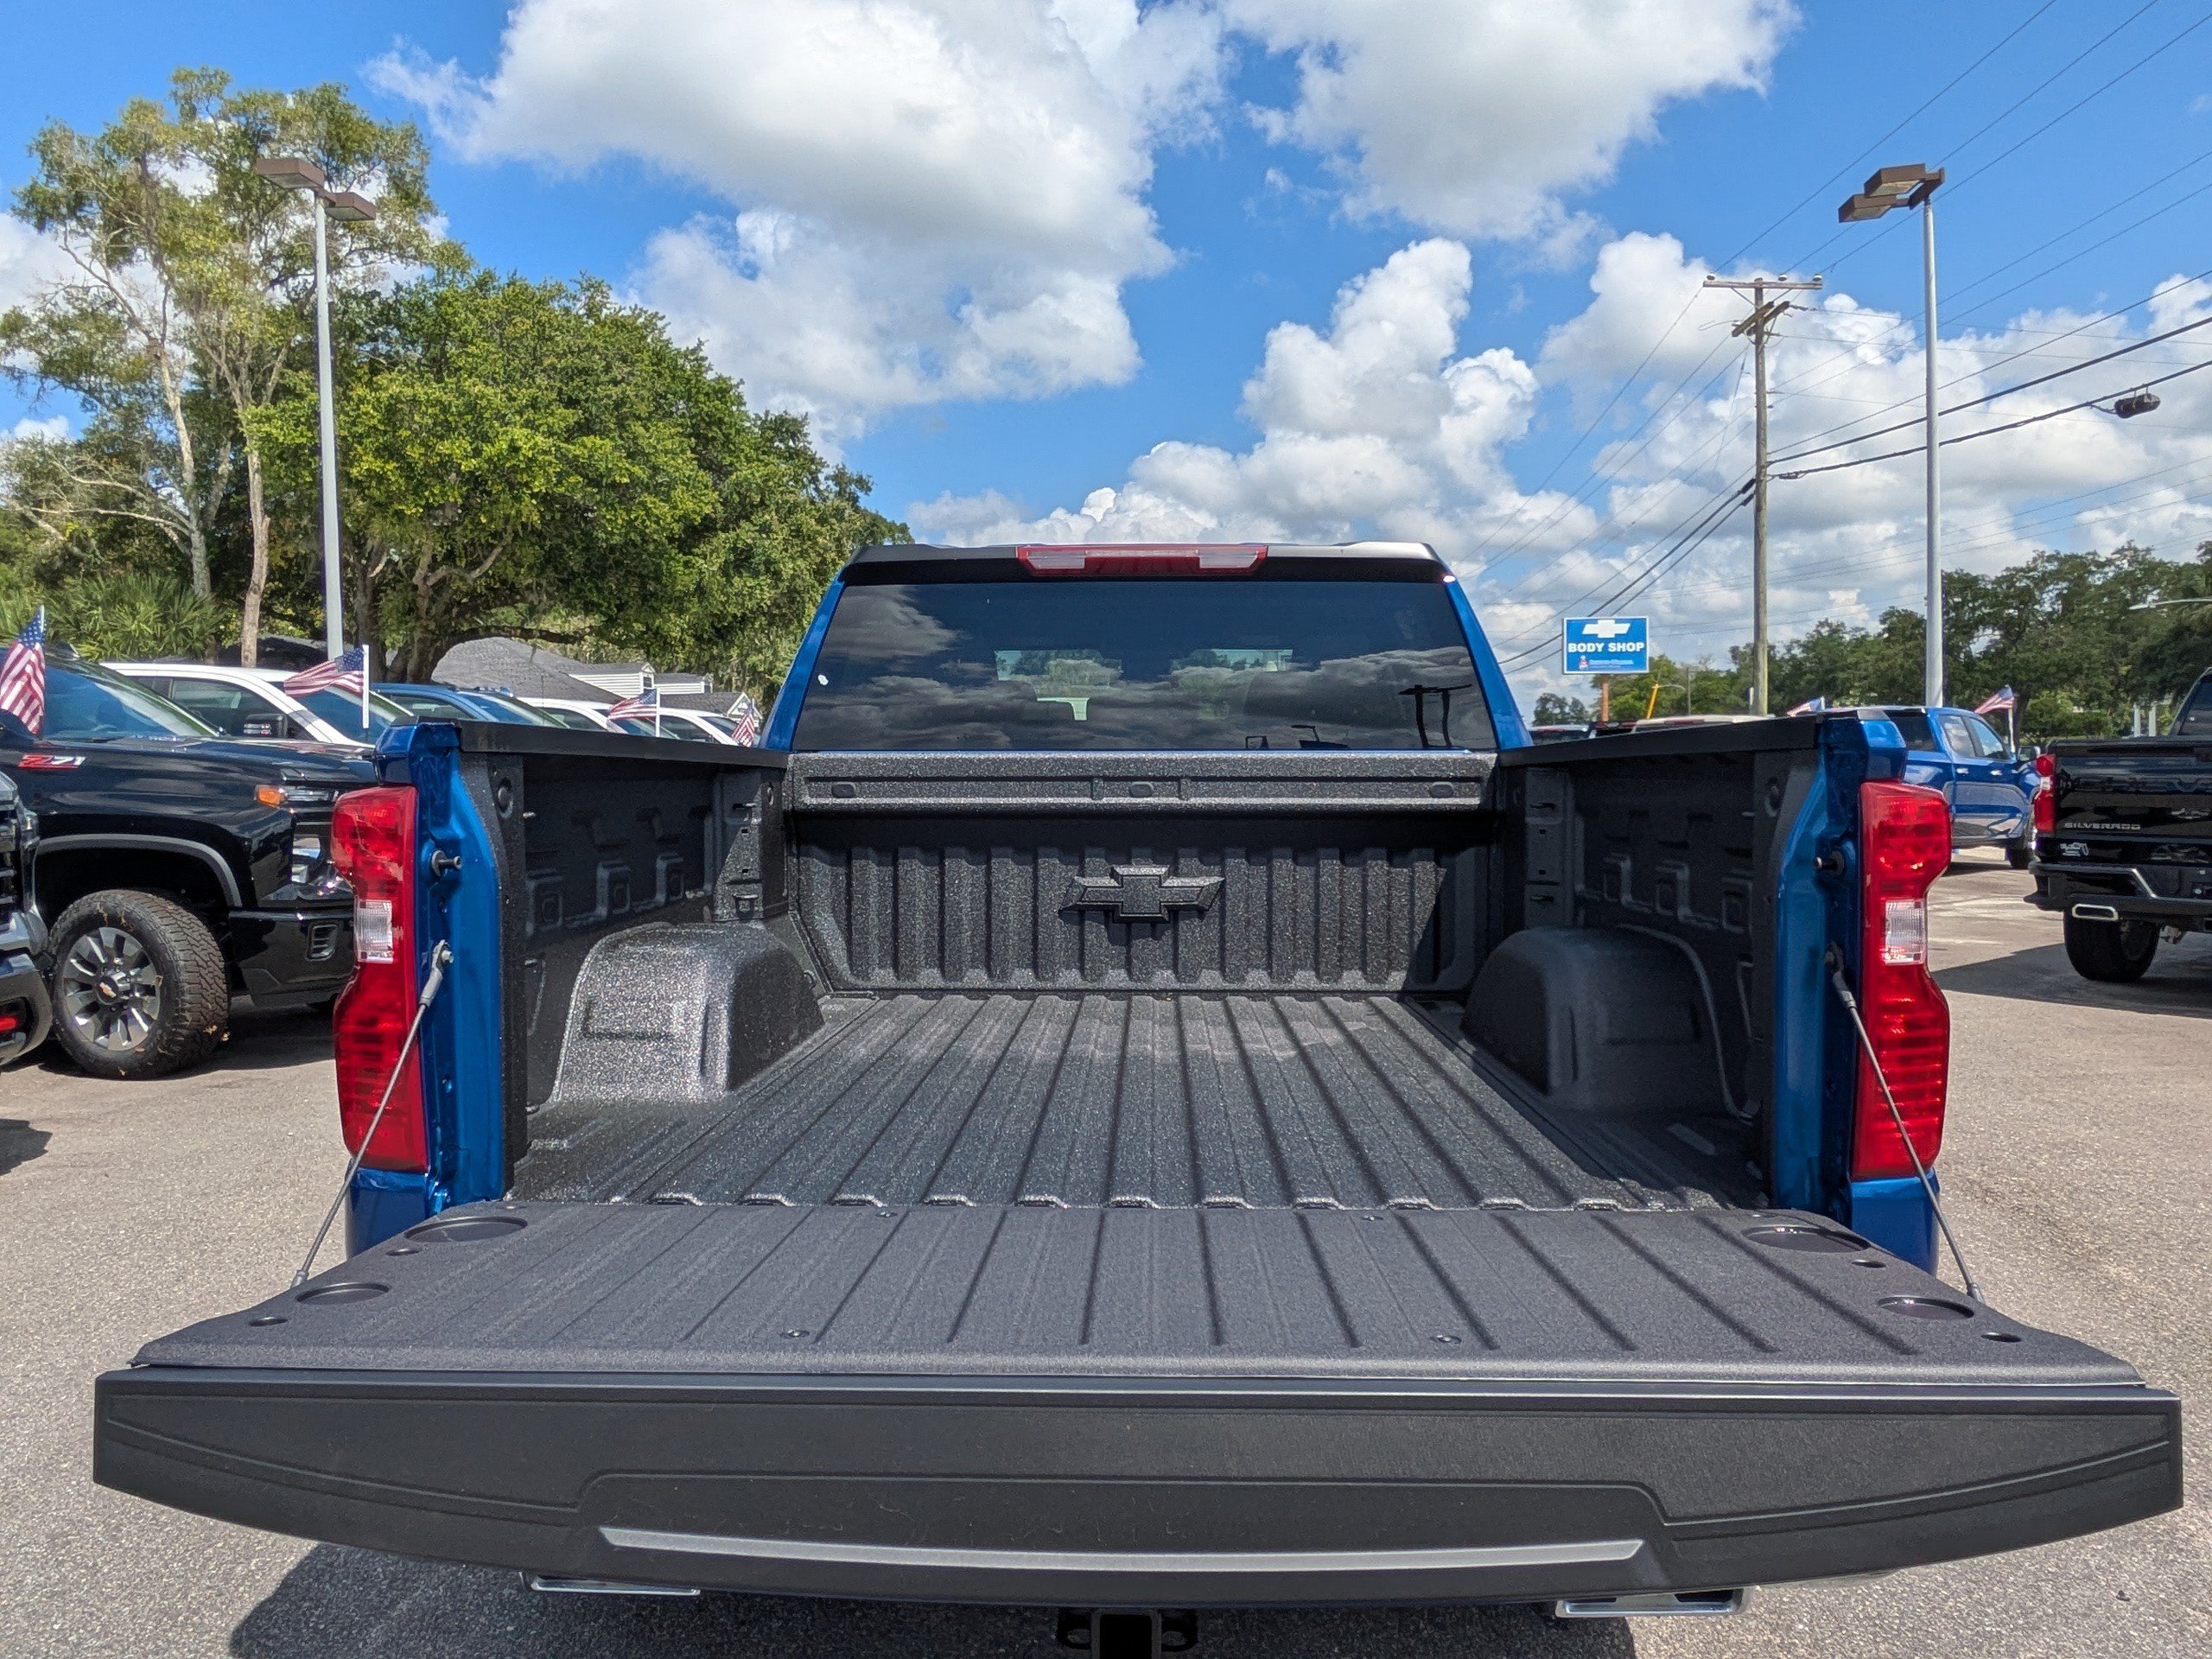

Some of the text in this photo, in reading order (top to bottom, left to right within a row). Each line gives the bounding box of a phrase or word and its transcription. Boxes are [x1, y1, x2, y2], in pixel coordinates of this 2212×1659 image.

[1567, 642, 1644, 653] BODY SHOP
[17, 754, 87, 769] Z71
